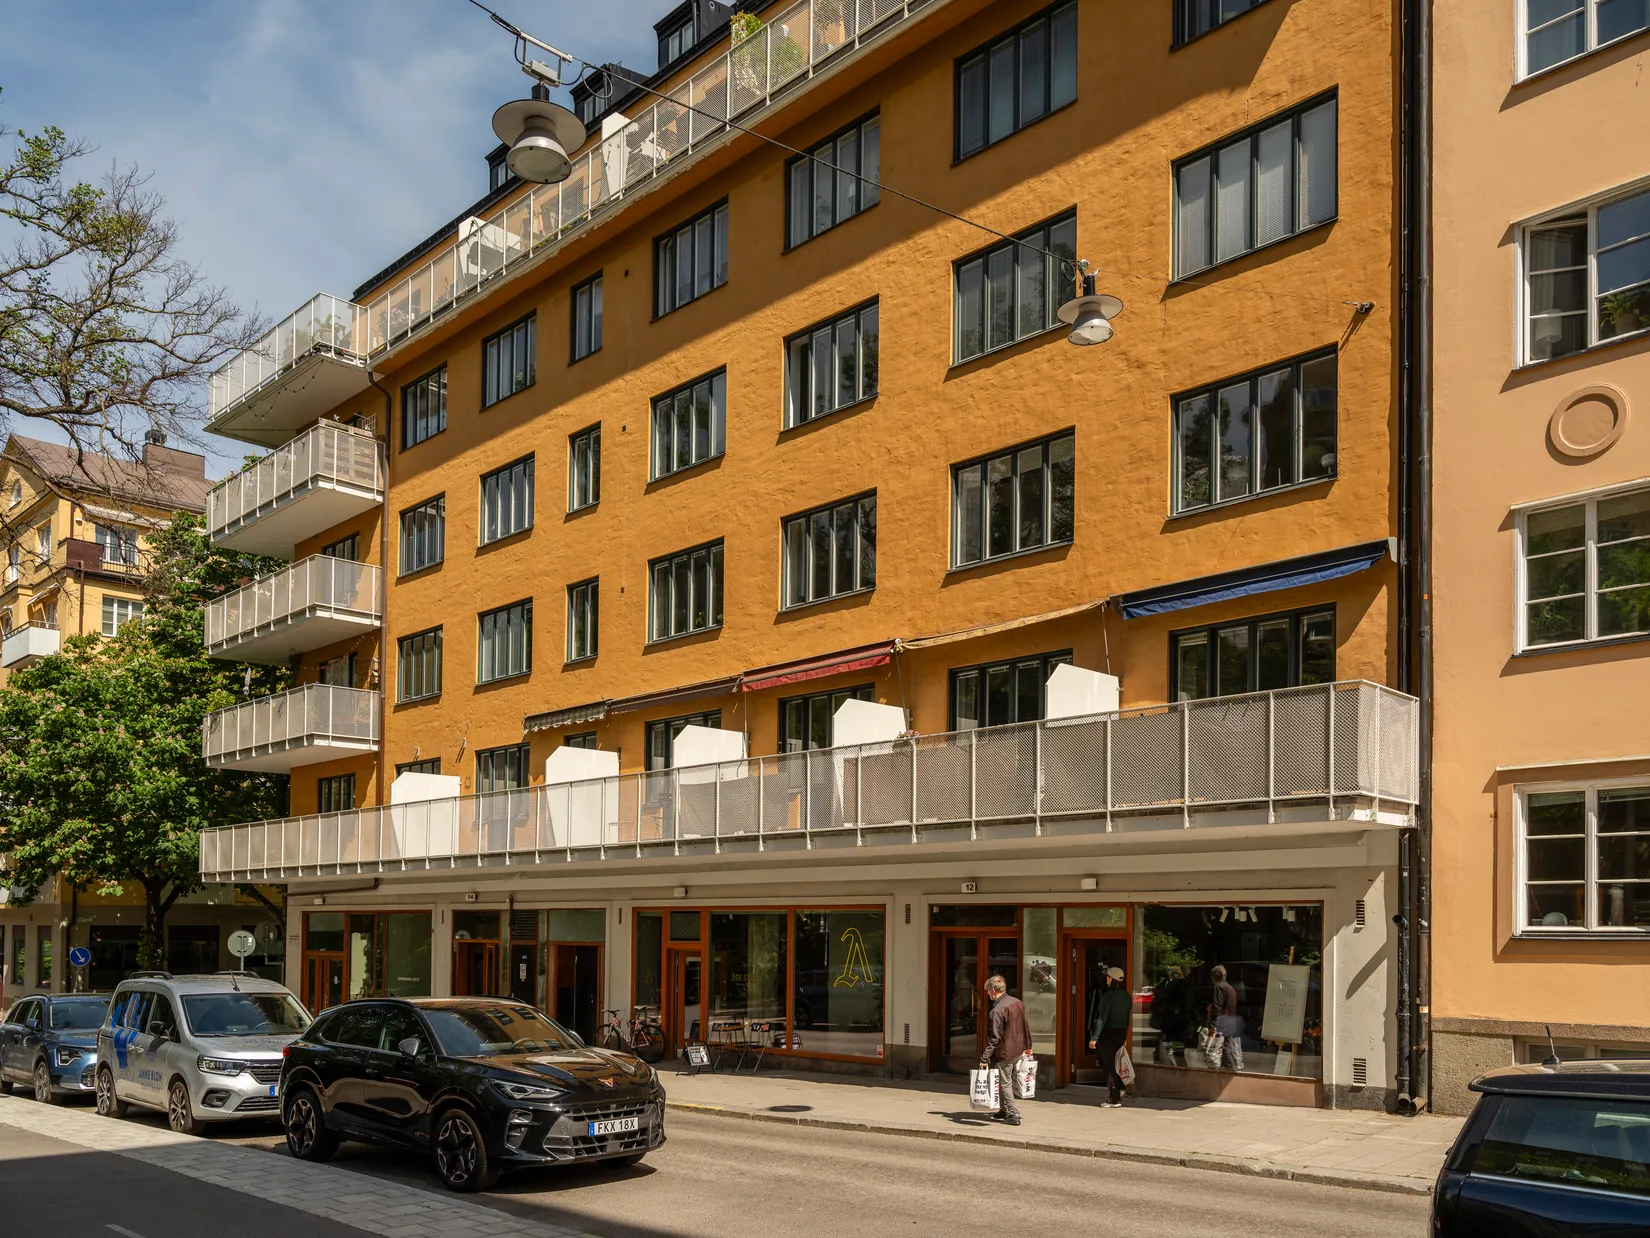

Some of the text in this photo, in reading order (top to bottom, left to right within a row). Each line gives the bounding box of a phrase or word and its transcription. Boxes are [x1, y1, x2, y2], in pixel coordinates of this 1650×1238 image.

[833, 927, 873, 988] A
[598, 1119, 634, 1133] FKX 18X
